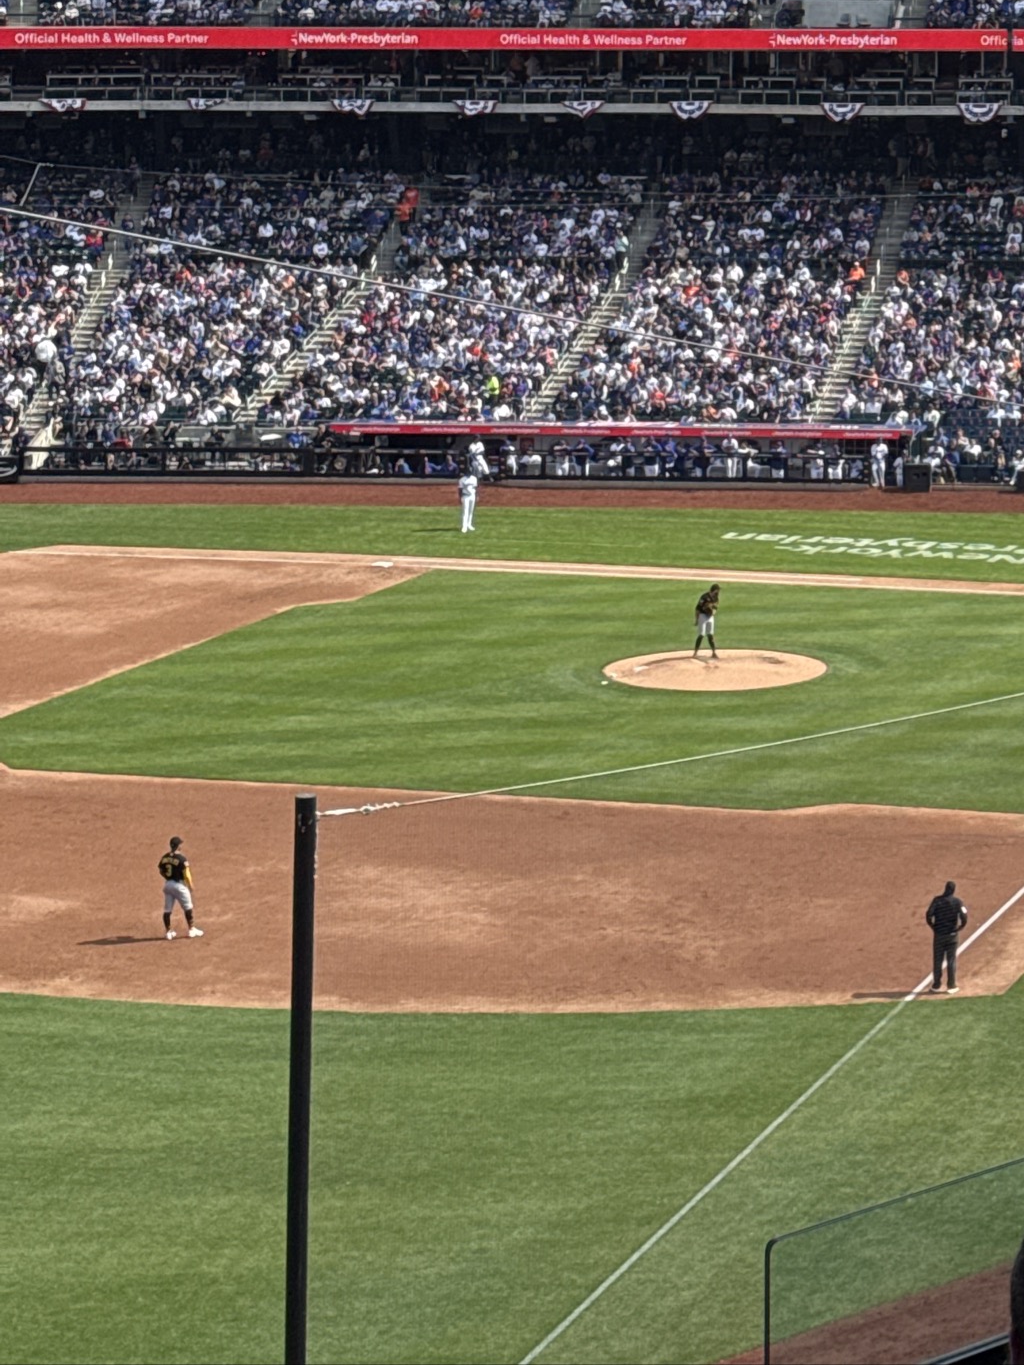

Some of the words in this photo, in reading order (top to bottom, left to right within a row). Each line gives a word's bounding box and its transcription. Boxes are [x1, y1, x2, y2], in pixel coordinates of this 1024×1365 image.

[15, 32, 58, 44] Official
[61, 32, 99, 44] Health
[102, 33, 111, 44] &
[114, 32, 164, 44] Wellness
[168, 33, 209, 44] Partner
[299, 31, 419, 46] NewYork-Presbyterian
[500, 33, 540, 45] Official
[543, 33, 579, 45] Health
[582, 34, 591, 45] &
[594, 34, 642, 46] Wellness
[646, 34, 687, 46] Partner
[776, 33, 898, 49] NewYork-Presbyterian
